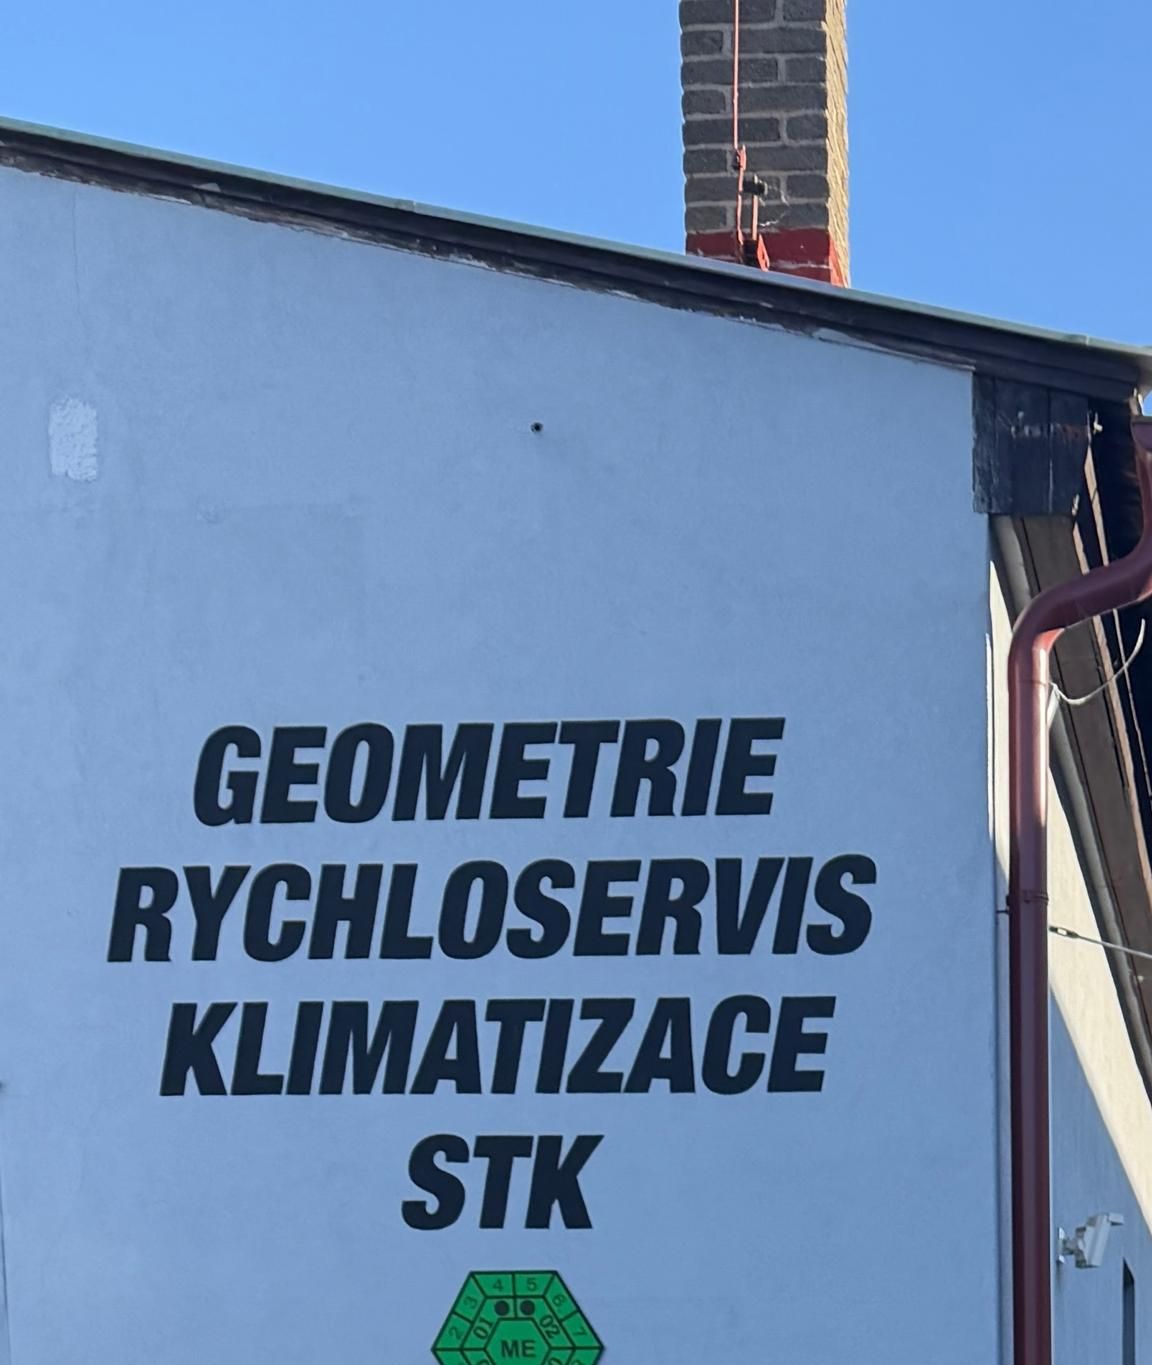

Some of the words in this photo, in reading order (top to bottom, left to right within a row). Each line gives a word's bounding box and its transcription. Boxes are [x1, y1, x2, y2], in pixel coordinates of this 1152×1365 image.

[194, 717, 785, 826] GEOMETRIE
[108, 854, 877, 962] RYCHLOSERVIS
[160, 995, 836, 1096] KLIMATIZACE
[402, 1134, 604, 1230] STK
[493, 1279, 503, 1291] 4
[526, 1278, 538, 1291] 5
[449, 1326, 462, 1340] 2
[539, 1315, 561, 1339] 02
[572, 1326, 586, 1338] 7
[501, 1339, 537, 1358] ME
